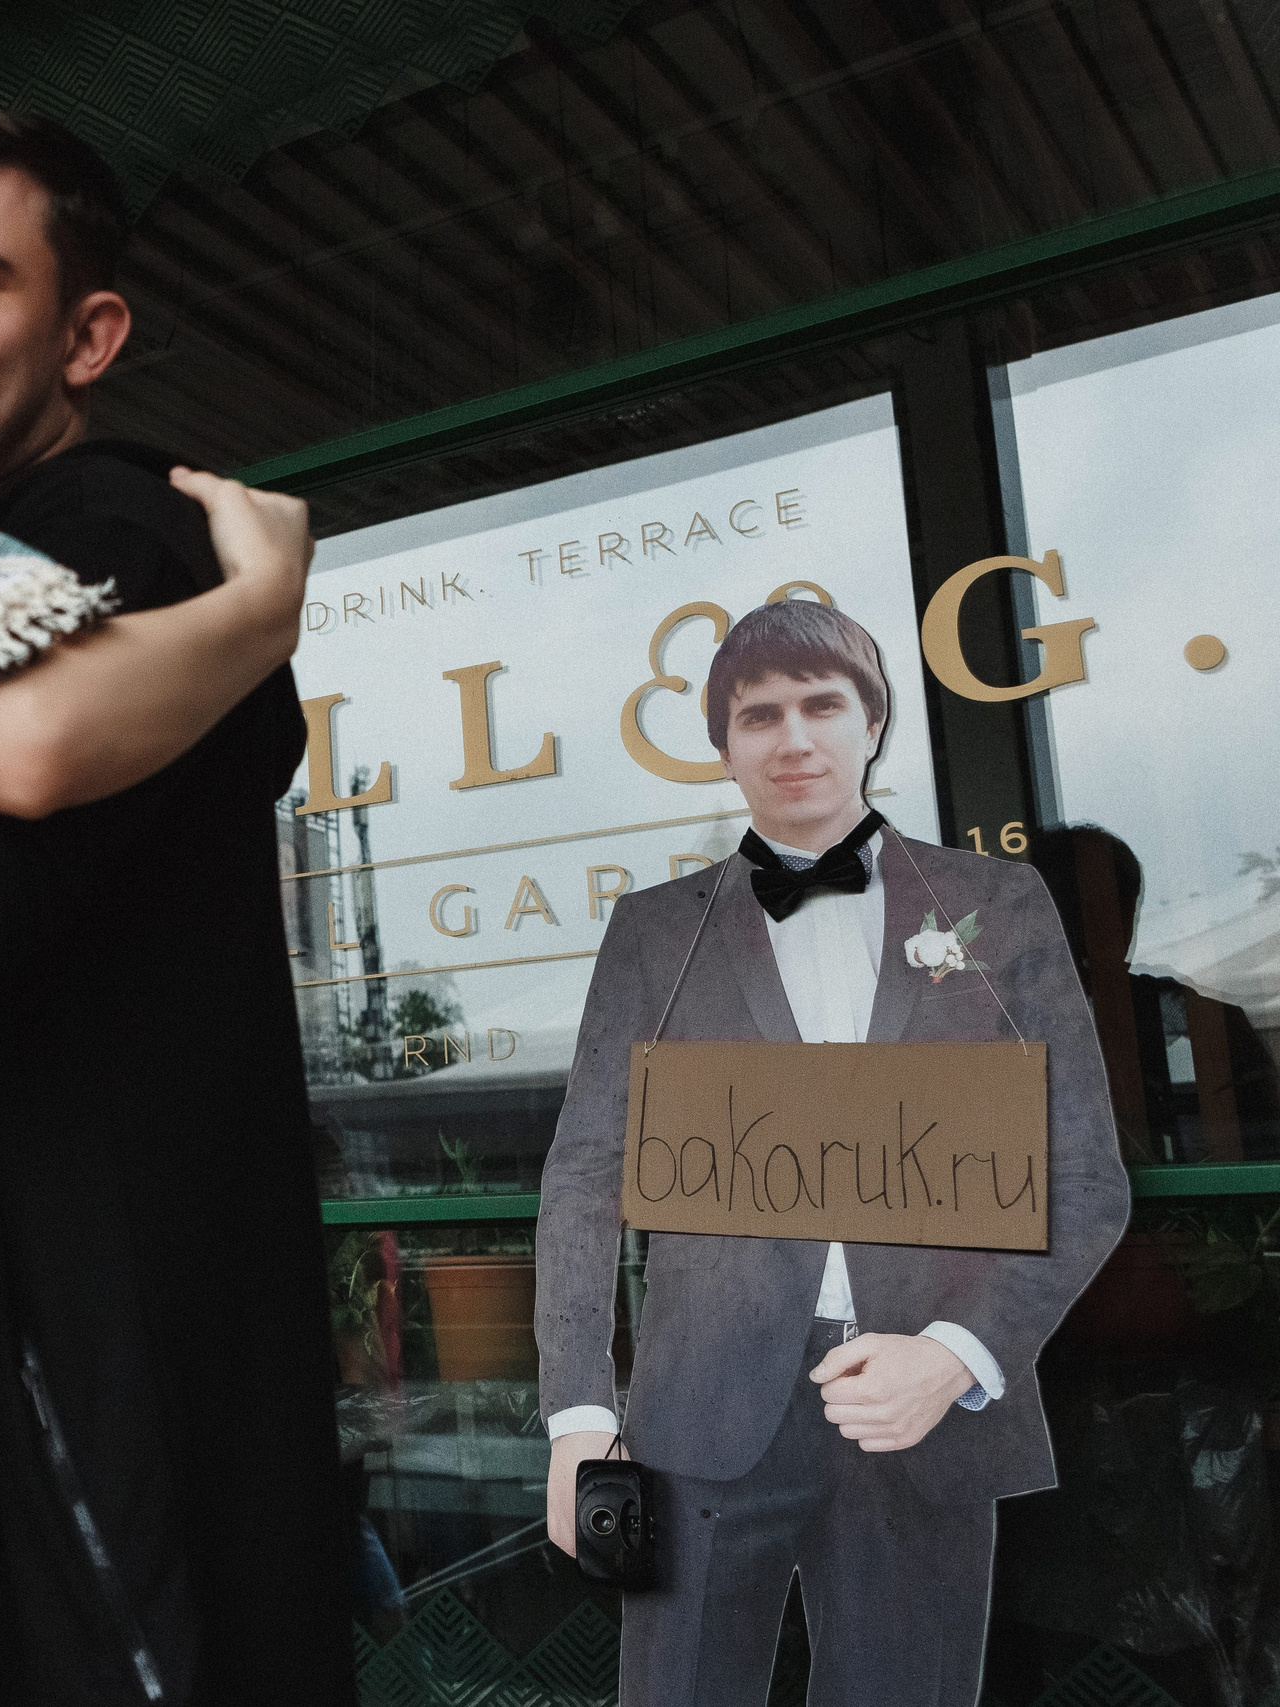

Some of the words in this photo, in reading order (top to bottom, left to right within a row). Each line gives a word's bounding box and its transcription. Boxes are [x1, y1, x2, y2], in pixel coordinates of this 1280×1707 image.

[305, 571, 485, 632] DRINK.
[518, 488, 806, 582] TERRACE
[403, 1028, 516, 1068] RND
[637, 1067, 1037, 1214] bakaruk.ru
